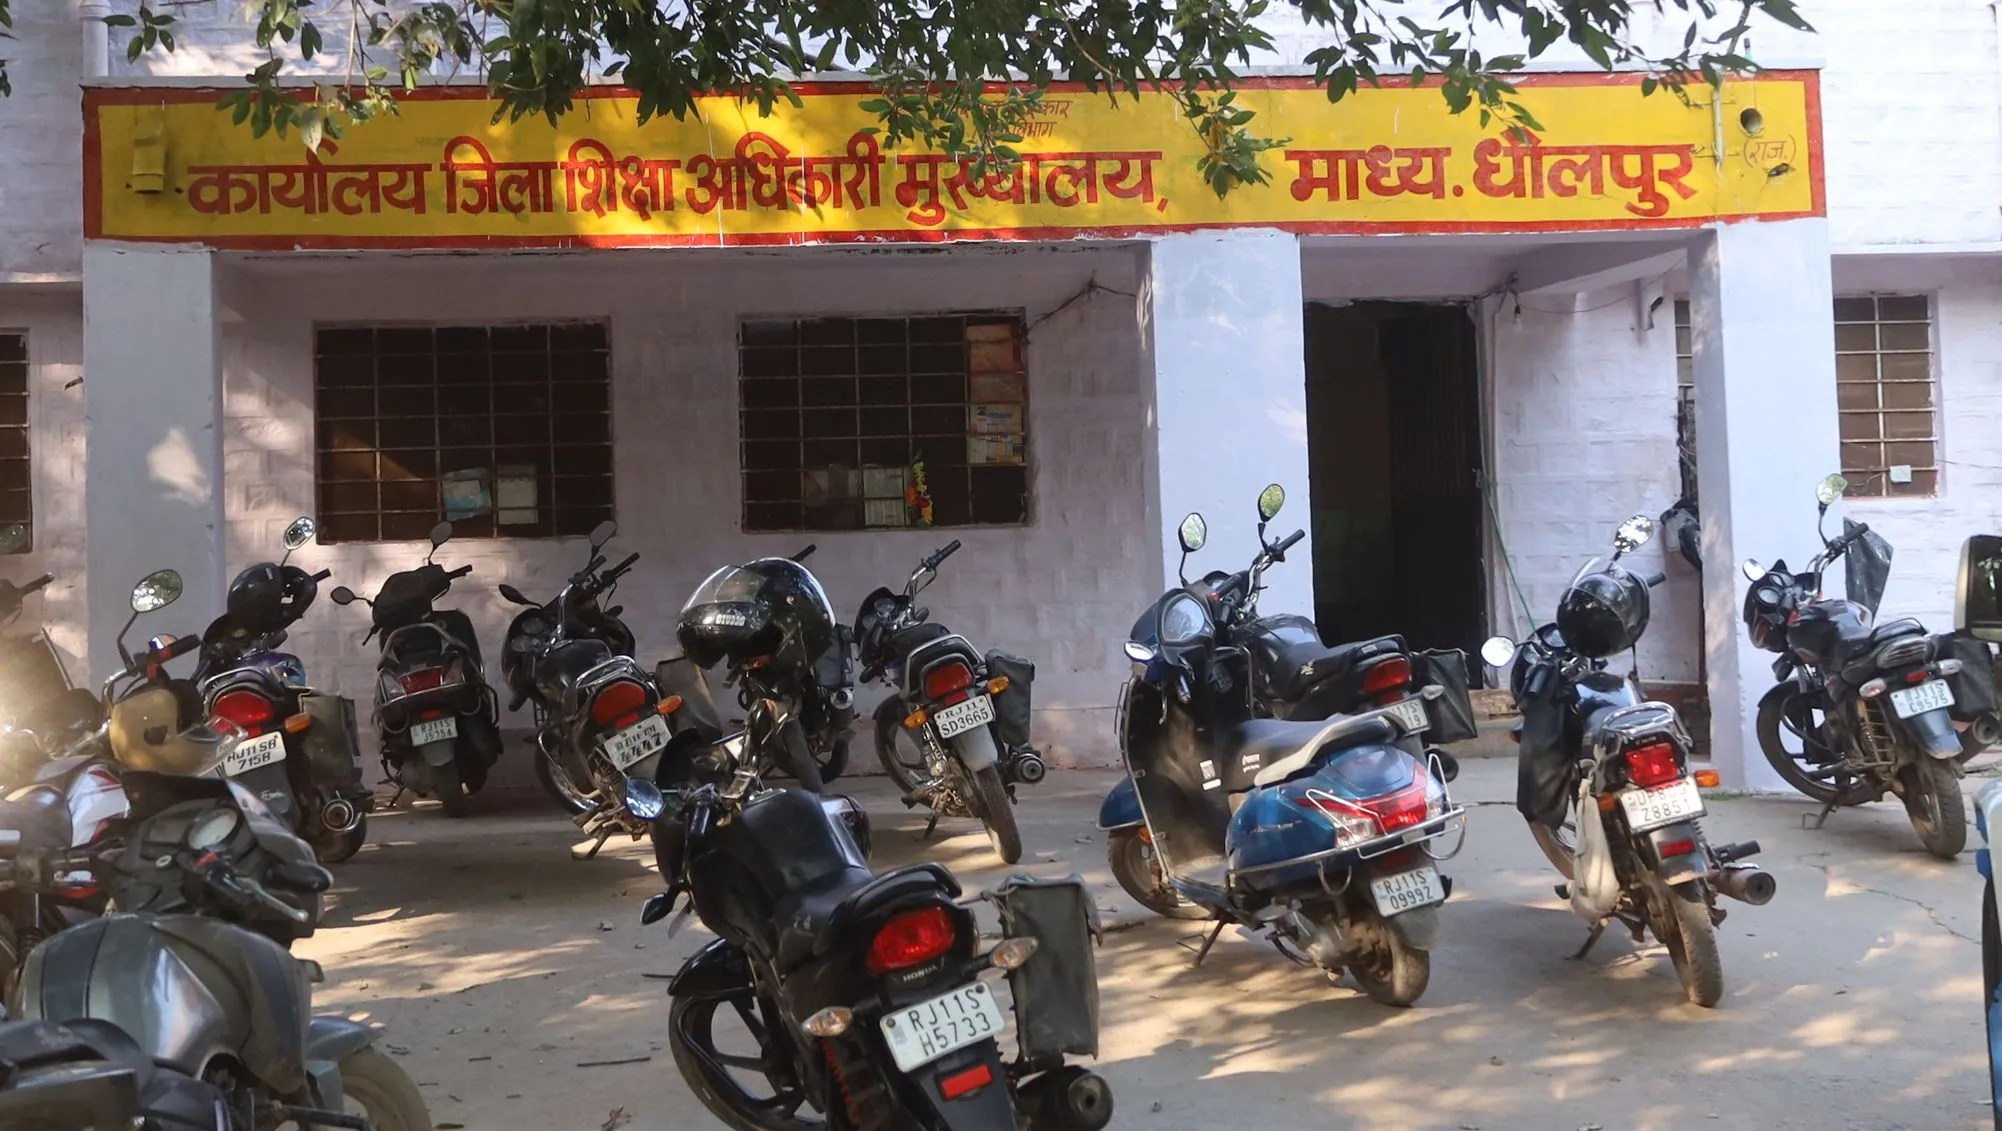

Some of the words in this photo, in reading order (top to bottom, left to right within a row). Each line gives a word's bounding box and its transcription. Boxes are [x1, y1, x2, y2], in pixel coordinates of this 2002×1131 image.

[1743, 134, 1797, 168] (राज.)
[187, 137, 432, 216] कार्यालय
[440, 135, 557, 216] जिला
[558, 138, 682, 221] शिक्षा
[685, 131, 886, 215] अधिकारी
[1284, 144, 1464, 202] माध्य.
[1473, 127, 1698, 217] धौलपुर
[941, 707, 989, 736] SD3665
[944, 701, 977, 719] RJ11
[1641, 799, 1691, 822] Z8851
[1383, 870, 1426, 894] RJ11S
[1390, 885, 1433, 910] 09992
[903, 964, 938, 982] HONDA
[908, 988, 980, 1032] RJ11S
[919, 1012, 991, 1057] H5733
